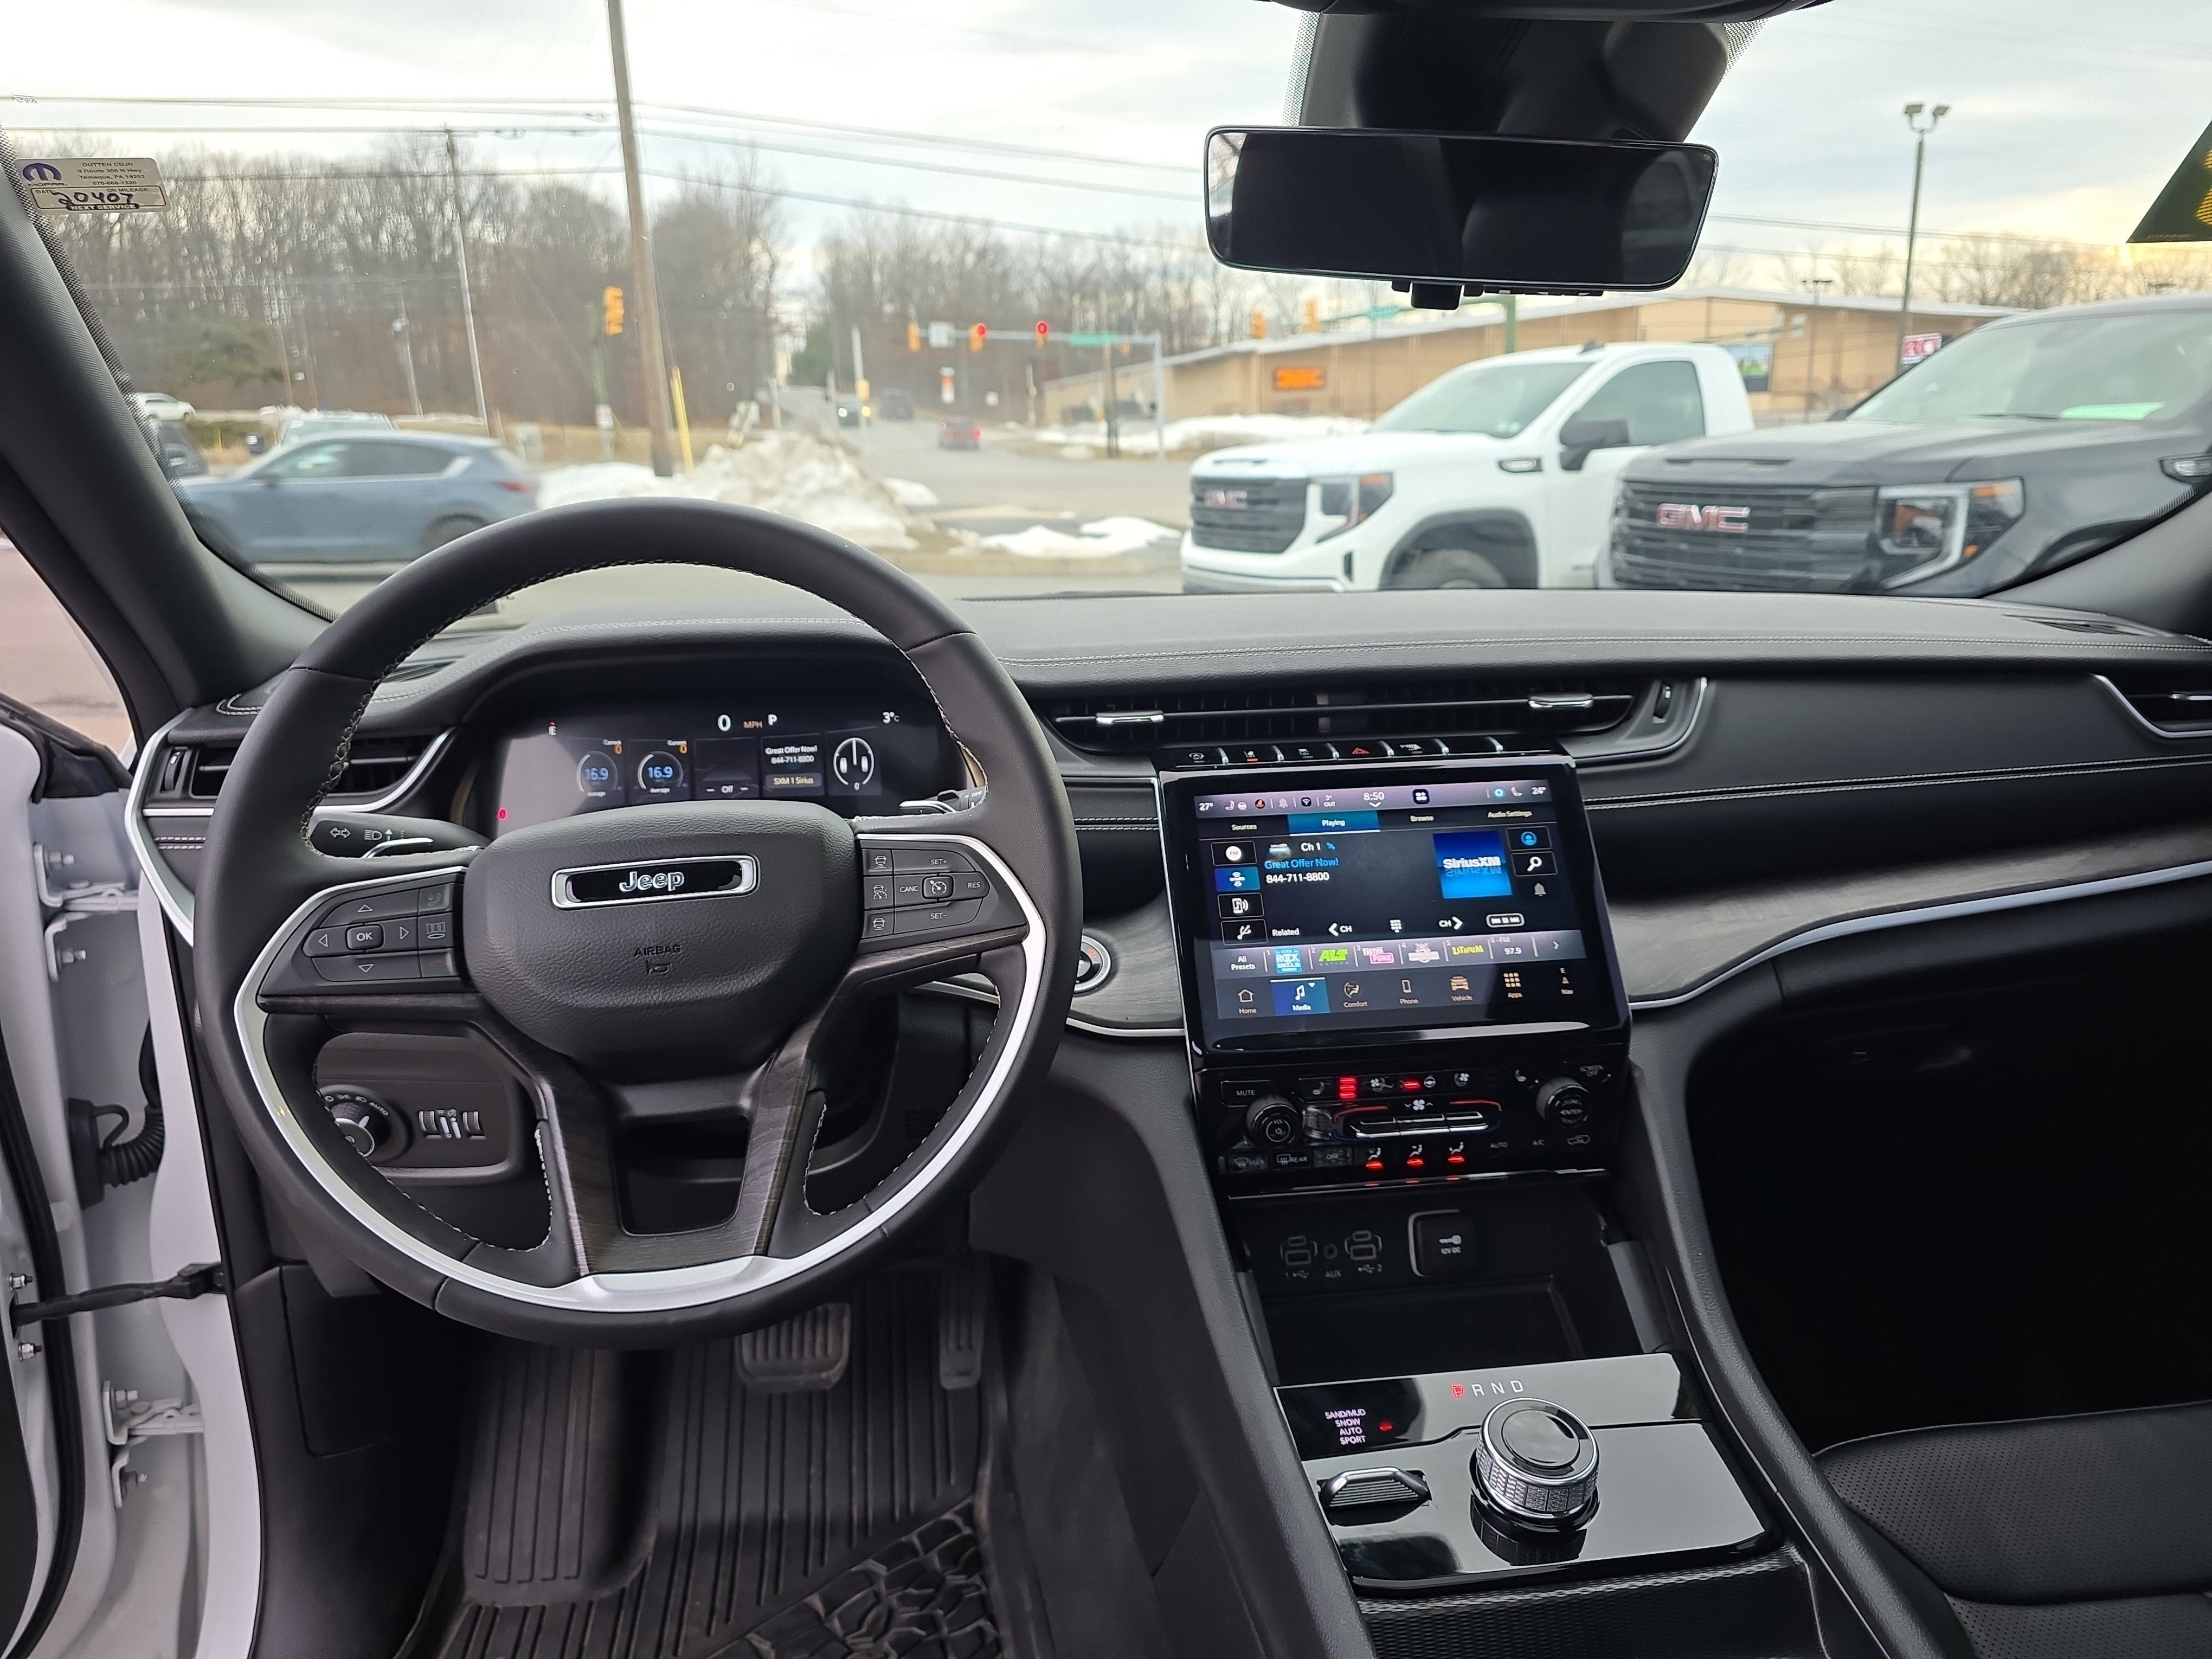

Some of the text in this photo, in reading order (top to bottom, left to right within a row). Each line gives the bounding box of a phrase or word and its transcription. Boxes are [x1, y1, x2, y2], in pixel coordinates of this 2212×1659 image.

[1657, 503, 1751, 533] GMC
[717, 715, 731, 731] 0
[743, 721, 763, 729] MPH
[768, 714, 777, 726] P
[584, 767, 609, 781] 16.9
[647, 766, 674, 779] 16.9
[1363, 792, 1385, 801] 8:50
[1199, 802, 1214, 811] 27°
[1301, 843, 1315, 852] Ch
[1264, 857, 1339, 870] Great Offer Now!
[1443, 856, 1501, 869] SiriusXM
[619, 871, 685, 892] Jeep
[1265, 872, 1330, 884] 844-711-8800
[1272, 928, 1300, 936] Related
[1339, 925, 1353, 933] CH
[356, 931, 374, 942] OK
[634, 944, 683, 957] AIRBAG
[1319, 949, 1348, 962] ALT
[1276, 953, 1300, 963] ROCK
[1324, 1270, 1342, 1278] AUX
[1452, 1380, 1524, 1398] P R N D
[1324, 1408, 1366, 1419] SAND/MUD
[1335, 1418, 1360, 1427] SNOW
[1340, 1426, 1363, 1436] AUTO
[1340, 1435, 1366, 1445] SPORT
